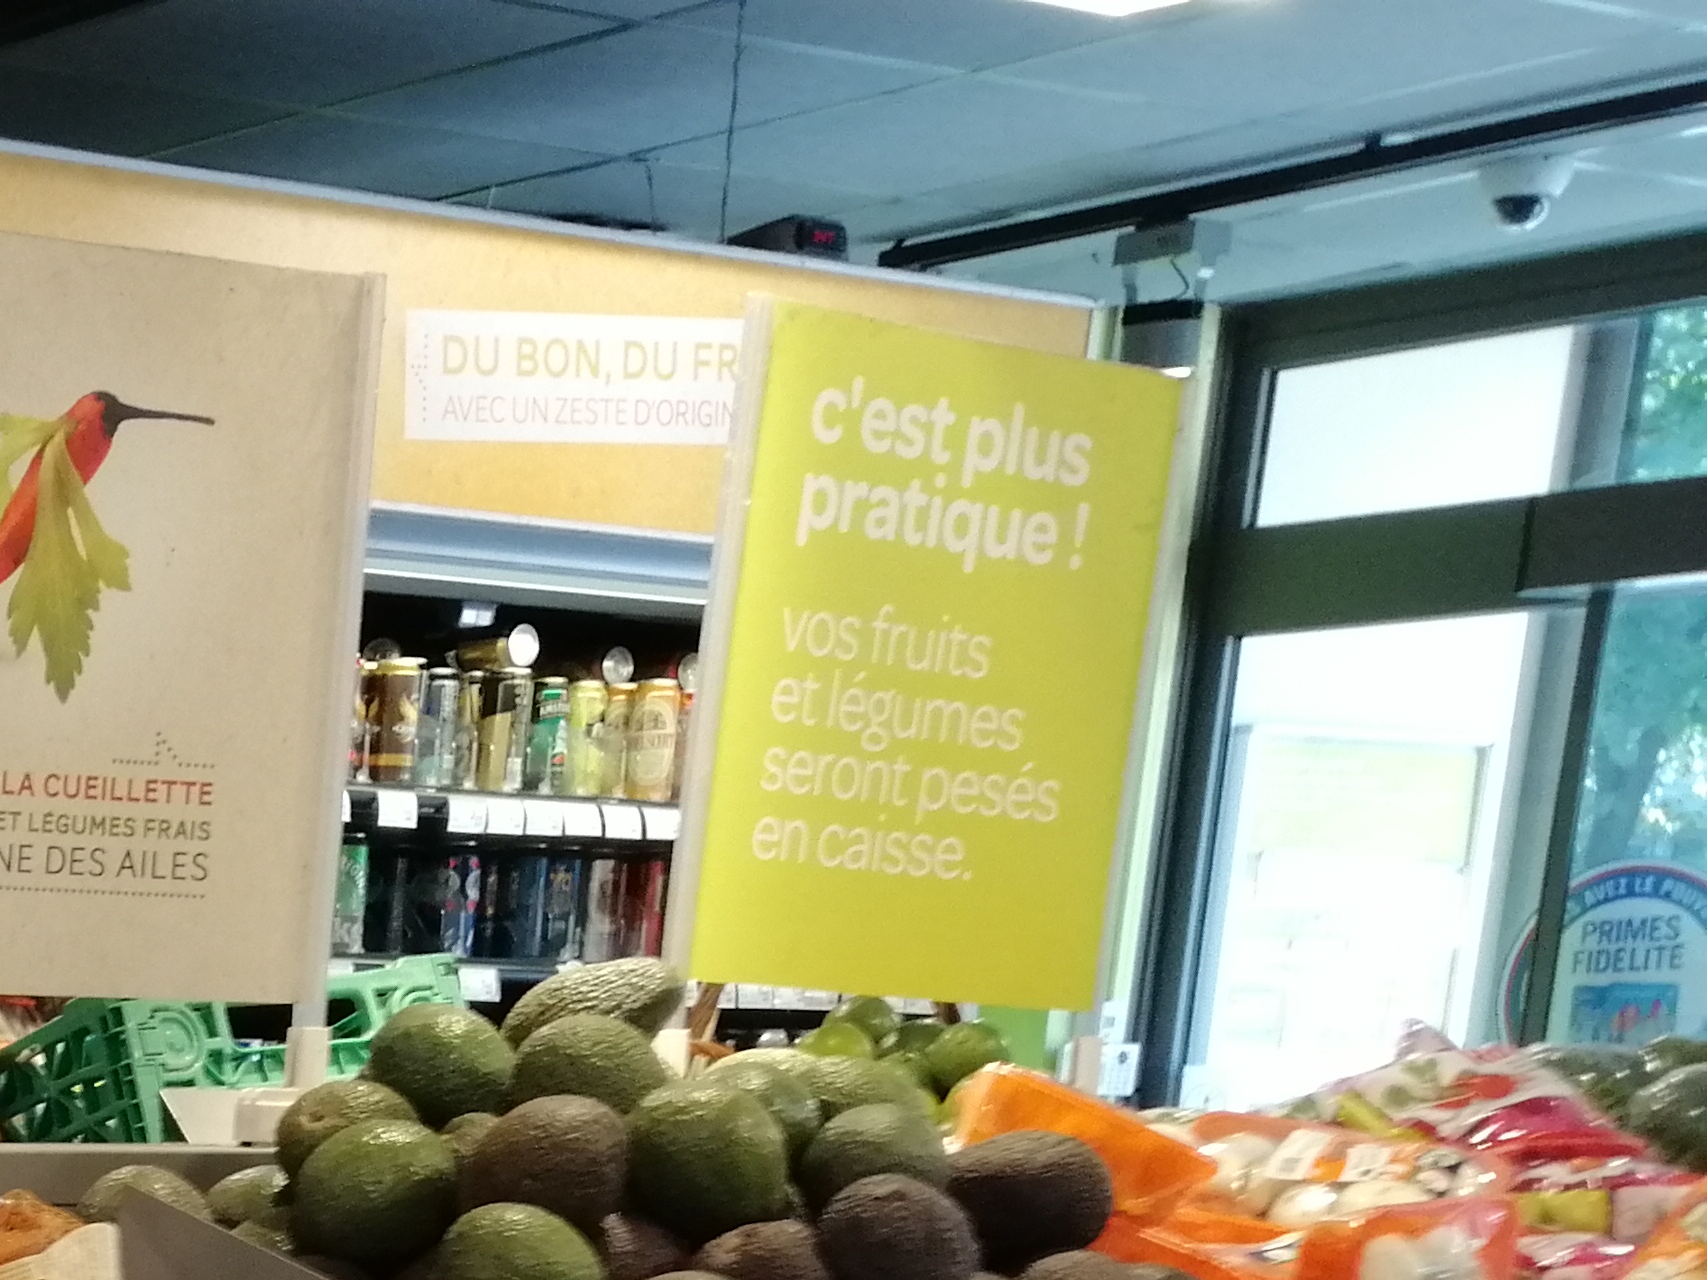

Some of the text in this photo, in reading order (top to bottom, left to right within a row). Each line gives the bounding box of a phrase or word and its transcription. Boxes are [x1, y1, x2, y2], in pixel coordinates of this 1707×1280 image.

[441, 334, 739, 387] DU BON, DU FR
[442, 396, 507, 426] AVEC
[511, 398, 548, 426] UN
[553, 398, 628, 426] ZESTE
[810, 377, 1093, 489] c'est plus
[796, 472, 1060, 574] pratique
[784, 605, 992, 680] vos fruits
[771, 668, 1025, 753] et légumes
[1, 770, 36, 798] LA
[43, 772, 214, 807] CUEILLETTE
[759, 737, 1061, 826] seront pesés
[27, 810, 137, 838] LÉGUMES
[144, 817, 212, 842] FRAIS
[752, 814, 973, 884] en caisse.
[45, 845, 107, 877] DES
[116, 849, 210, 883] AILES
[1581, 914, 1681, 944] PRIMES
